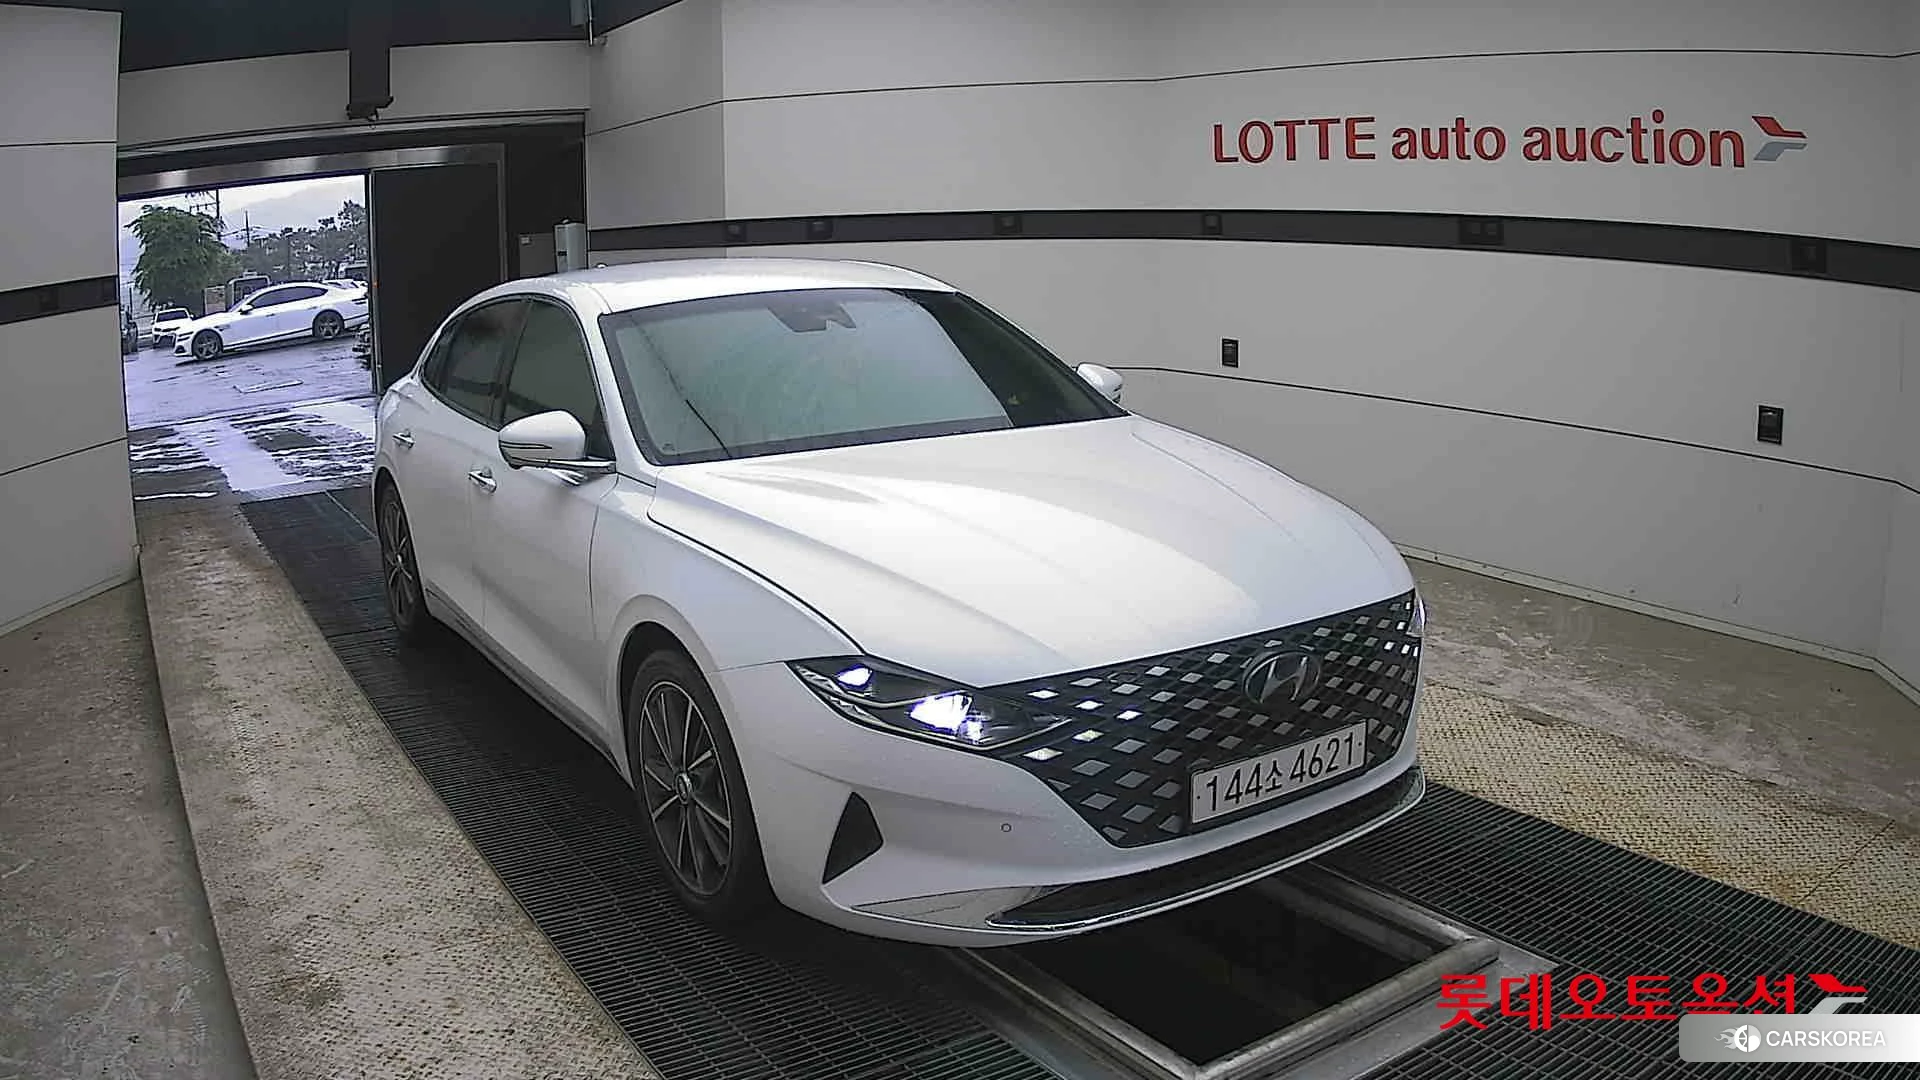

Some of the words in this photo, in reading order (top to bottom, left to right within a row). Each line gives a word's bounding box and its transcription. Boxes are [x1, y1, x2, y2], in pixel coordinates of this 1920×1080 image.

[1213, 117, 1376, 163] LOTTE
[1391, 117, 1507, 160] auto
[1522, 109, 1746, 168] auction
[1206, 760, 1282, 811] 144소
[1290, 732, 1354, 783] 4621
